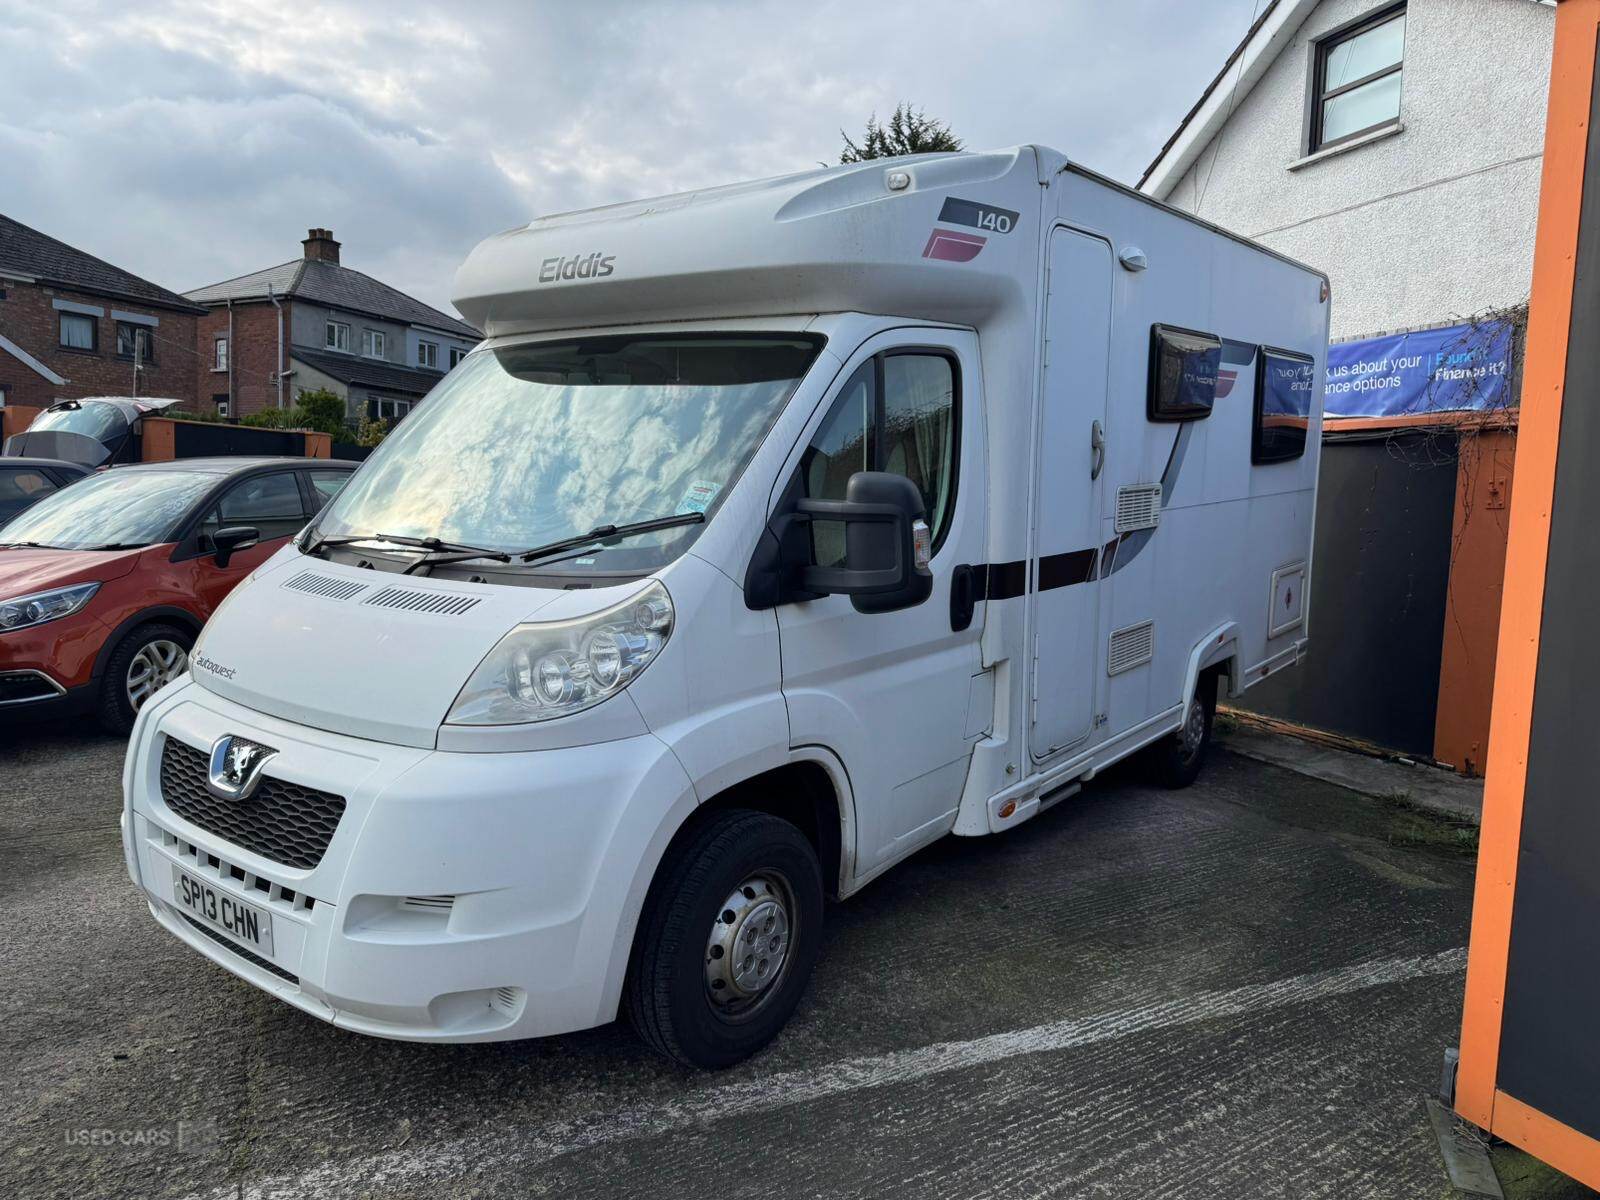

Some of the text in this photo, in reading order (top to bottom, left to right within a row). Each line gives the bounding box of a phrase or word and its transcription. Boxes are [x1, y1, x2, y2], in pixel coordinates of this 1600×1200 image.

[977, 211, 1011, 233] 140
[538, 252, 617, 283] Elddis
[1333, 365, 1348, 377] us
[1351, 357, 1388, 375] about
[1391, 355, 1423, 370] your
[1488, 361, 1507, 376] it?
[1325, 375, 1401, 394] ance options
[196, 656, 237, 680] autoquest
[181, 874, 259, 944] SP13 CHN
